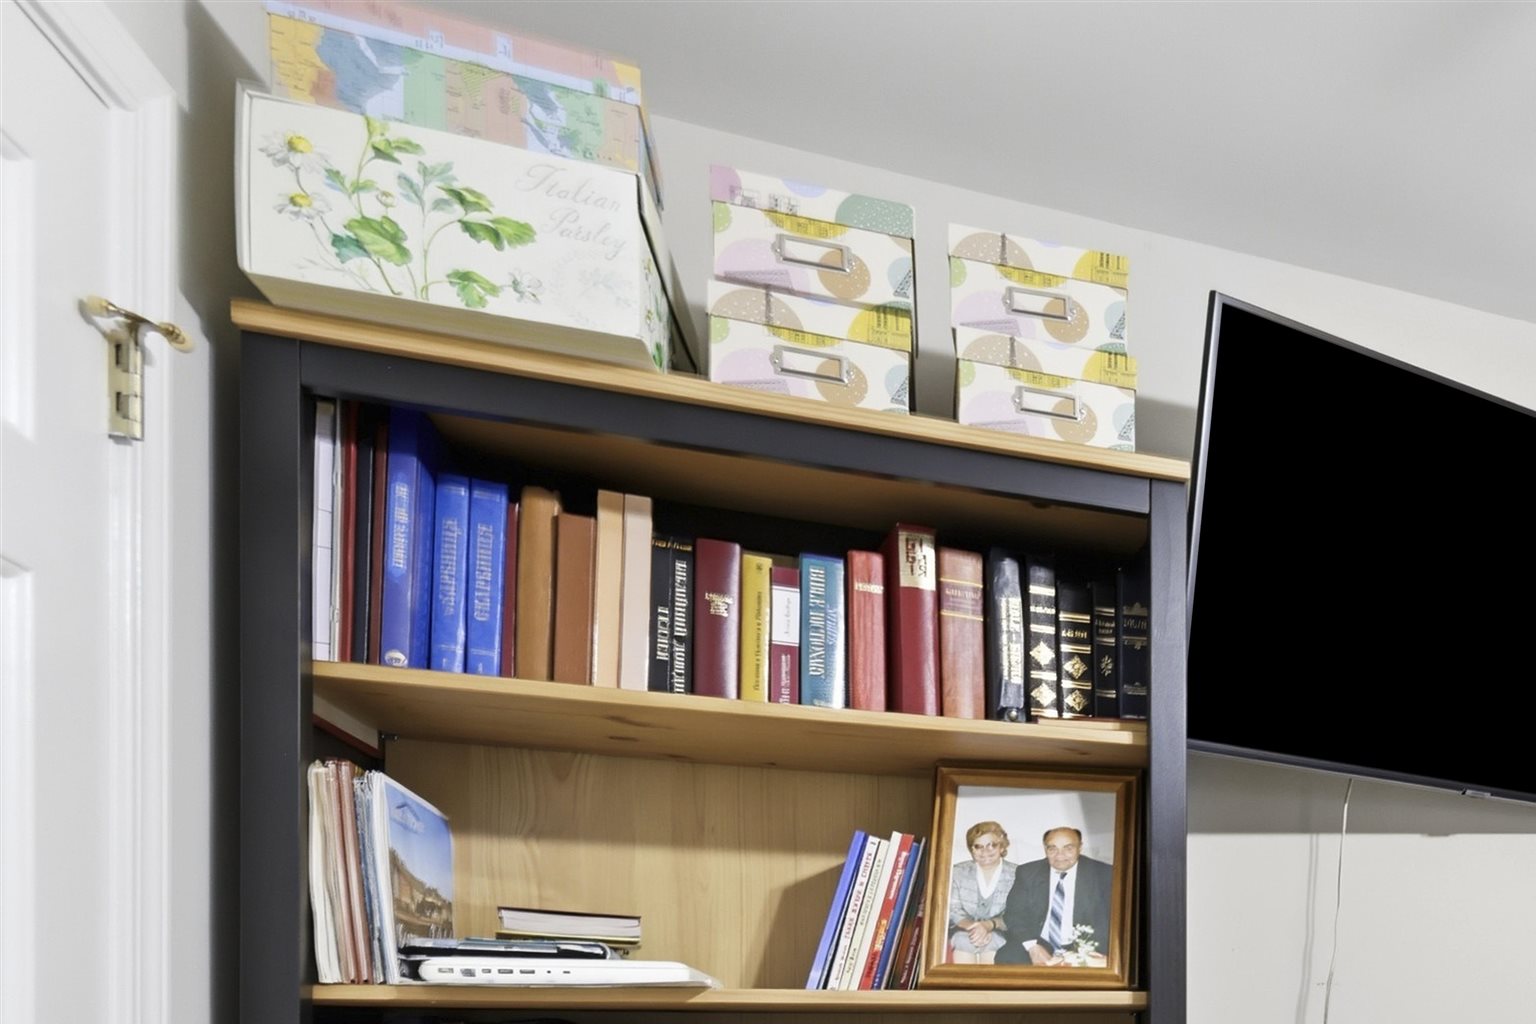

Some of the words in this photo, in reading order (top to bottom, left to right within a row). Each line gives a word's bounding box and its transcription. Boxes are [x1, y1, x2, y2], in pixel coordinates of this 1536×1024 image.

[514, 163, 620, 212] Italian
[543, 207, 627, 261] Parsley
[809, 566, 826, 607] BIBLE
[808, 608, 826, 679] DICTIONARY
